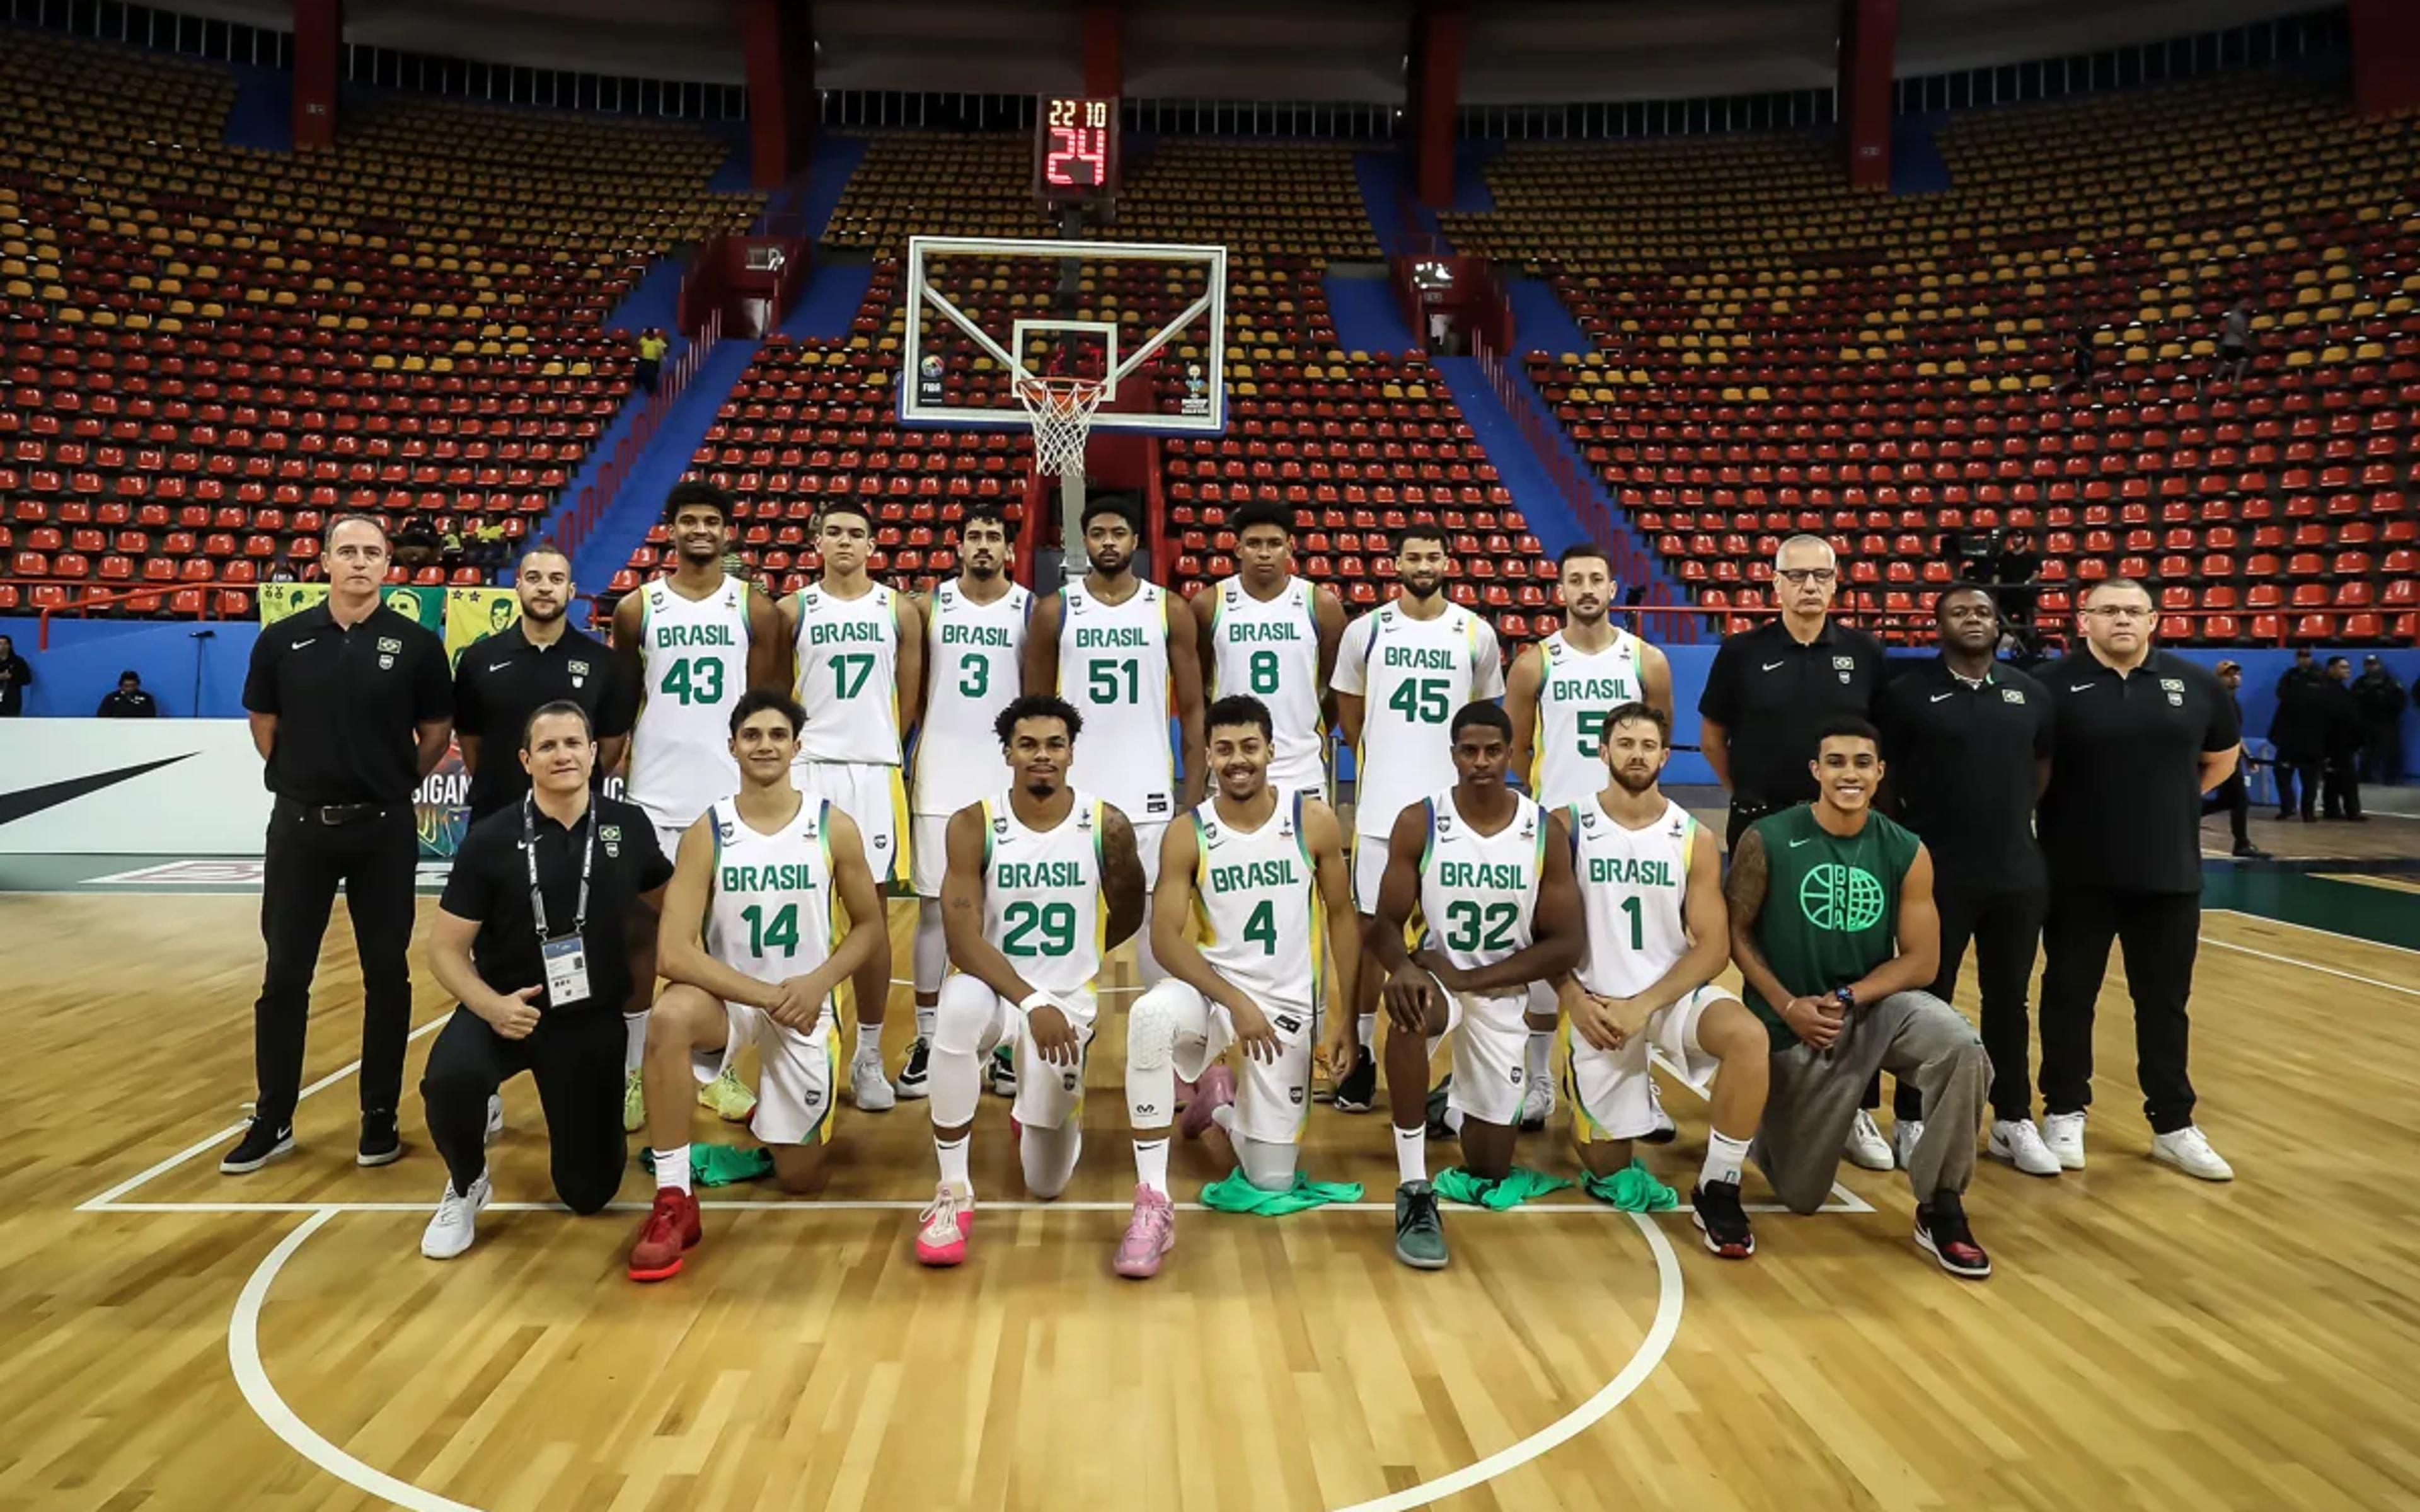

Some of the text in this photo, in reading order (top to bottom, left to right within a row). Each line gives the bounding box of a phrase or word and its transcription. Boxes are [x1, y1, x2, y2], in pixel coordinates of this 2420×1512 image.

[1049, 100, 1107, 127] 22 10
[1047, 127, 1105, 185] 24
[657, 624, 735, 648] BRASIL
[810, 622, 884, 644] BRASIL
[943, 624, 1011, 646] BRASIL
[1076, 628, 1149, 648] BRASIL
[1229, 622, 1300, 643] BRASIL
[827, 653, 875, 699] 17
[959, 653, 989, 698] 3
[1250, 650, 1279, 695] 8
[1385, 646, 1455, 670] BRASIL
[660, 656, 725, 706] 43
[1089, 658, 1138, 704] 51
[1389, 678, 1450, 724] 45
[1553, 679, 1631, 701] BRASIL
[1577, 711, 1608, 757] 5
[722, 864, 816, 892] BRASIL
[998, 862, 1086, 888] BRASIL
[1211, 859, 1298, 893] BRASIL
[1440, 861, 1527, 890] BRASIL
[1590, 858, 1676, 886] BRASIL
[1834, 864, 1846, 930] BRA
[741, 903, 800, 958] 14
[1002, 901, 1076, 957] 29
[1243, 900, 1277, 955] 4
[1447, 900, 1518, 952] 32
[1621, 896, 1642, 950] 1
